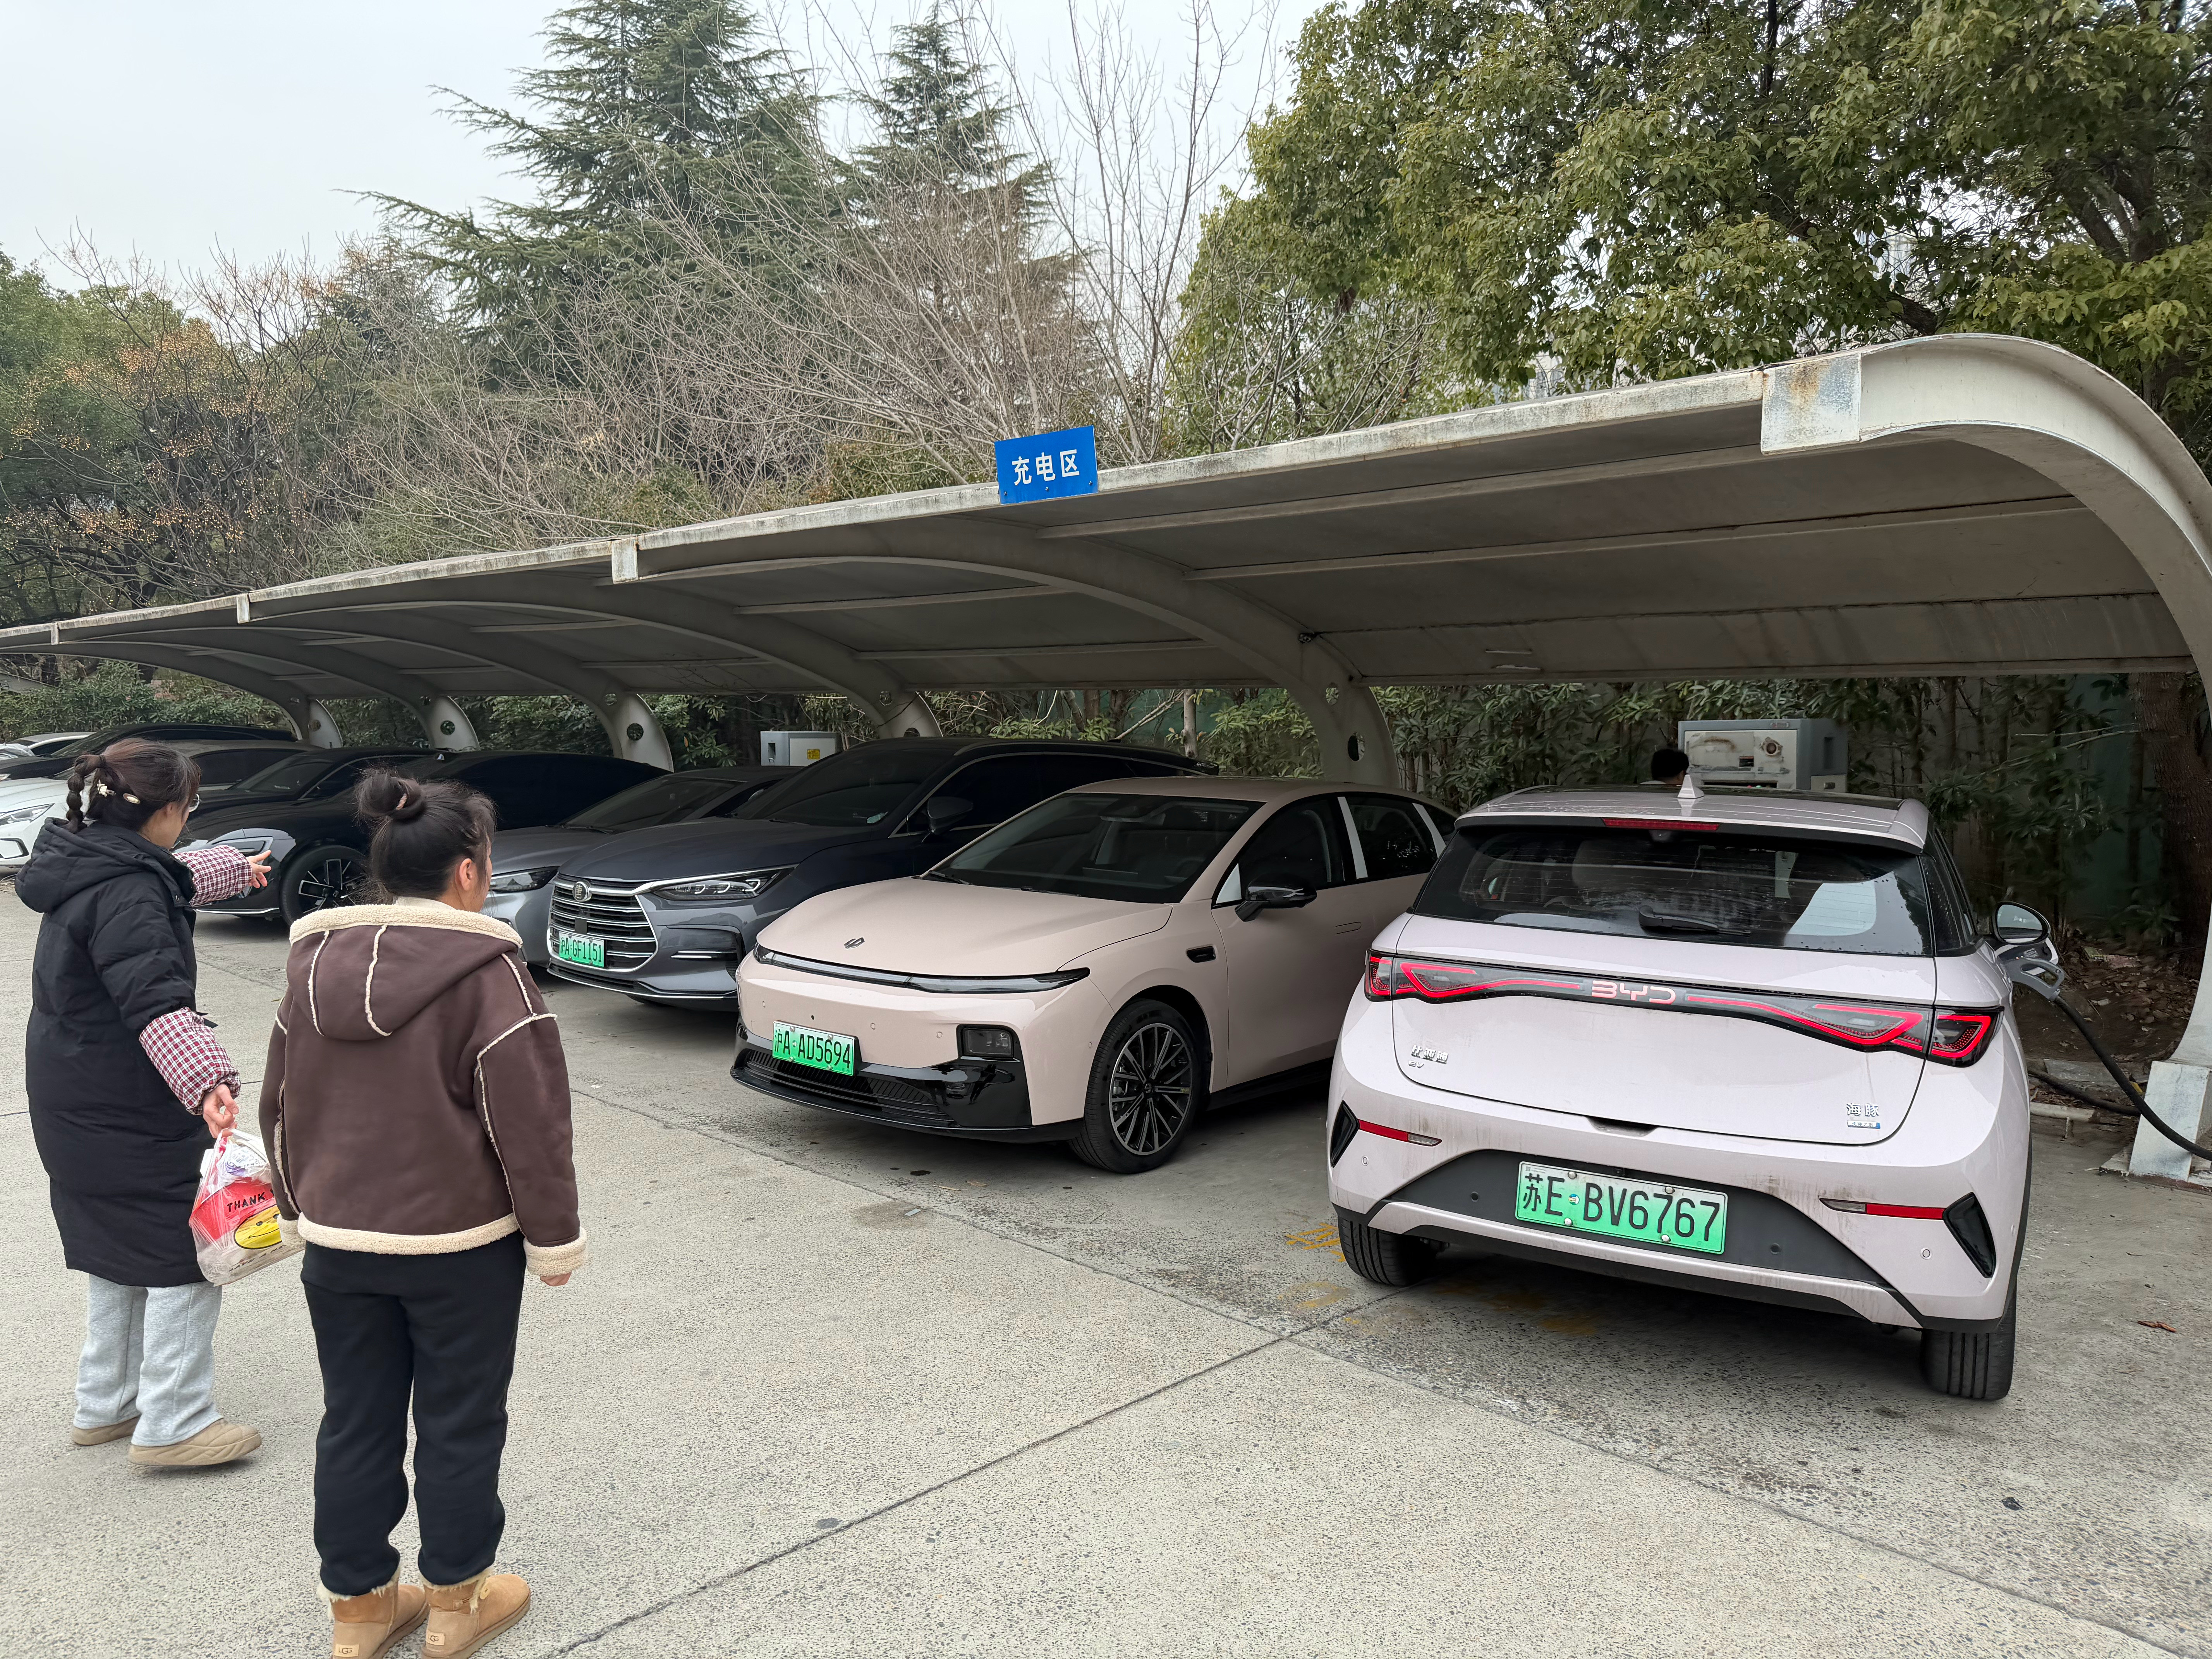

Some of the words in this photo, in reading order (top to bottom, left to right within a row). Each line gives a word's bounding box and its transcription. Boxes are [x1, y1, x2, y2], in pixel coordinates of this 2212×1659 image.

[1012, 449, 1080, 485] 充电区
[1592, 980, 1676, 1005] BYD
[1408, 1060, 1424, 1068] EV
[1412, 1045, 1449, 1064] 比亚迪
[1846, 1103, 1880, 1117] 海豚
[227, 1192, 265, 1212] THANK
